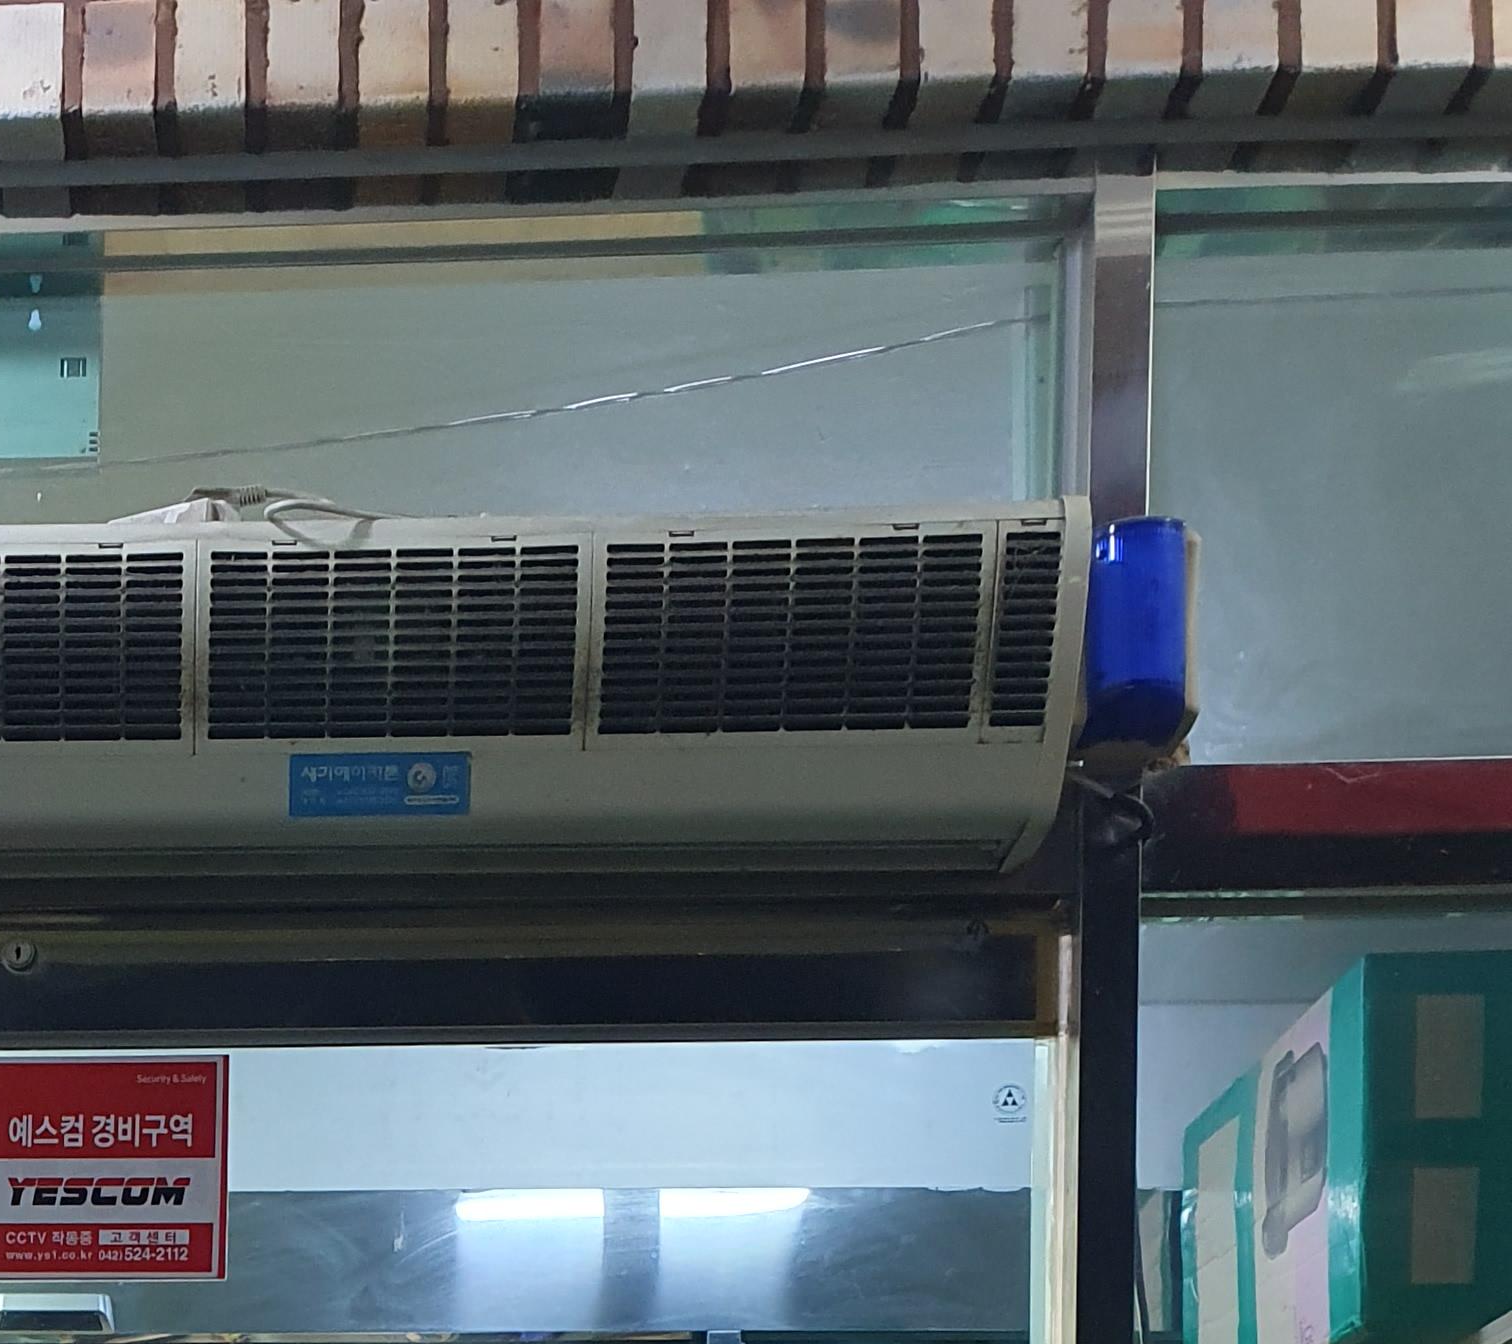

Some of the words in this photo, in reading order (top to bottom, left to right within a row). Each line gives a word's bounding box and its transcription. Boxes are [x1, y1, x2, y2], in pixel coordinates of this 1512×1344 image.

[8, 1114, 85, 1148] 예스컴
[91, 1114, 194, 1148] 경비구역
[7, 1177, 191, 1206] YESCOM
[5, 1231, 46, 1245] CCTV
